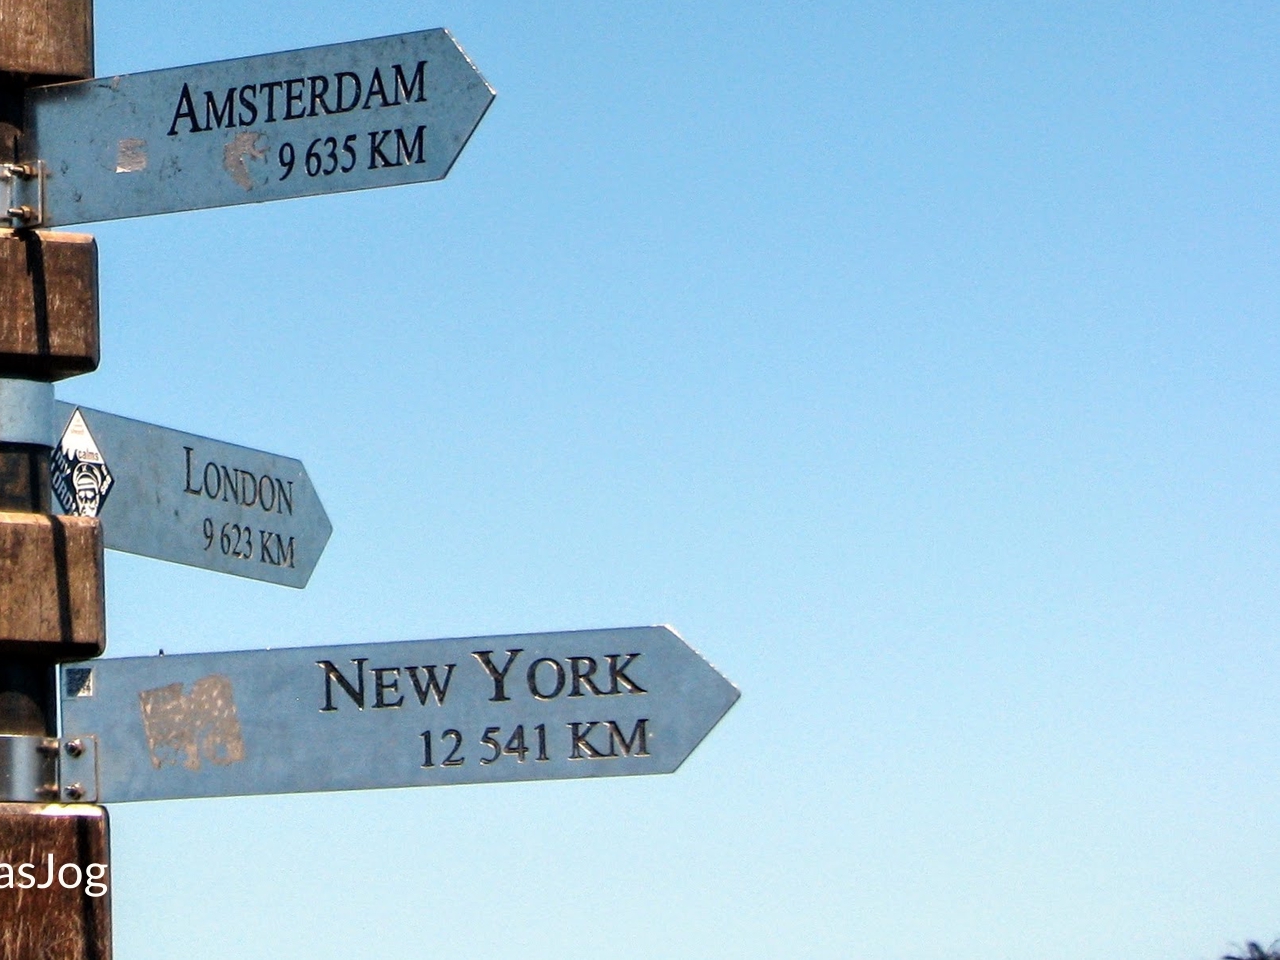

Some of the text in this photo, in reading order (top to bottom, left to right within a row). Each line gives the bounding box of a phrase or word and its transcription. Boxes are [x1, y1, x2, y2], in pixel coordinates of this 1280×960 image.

[278, 125, 427, 181] 9 635 KM
[202, 517, 295, 568] 9 623 KM
[419, 718, 651, 768] 12 541 KM
